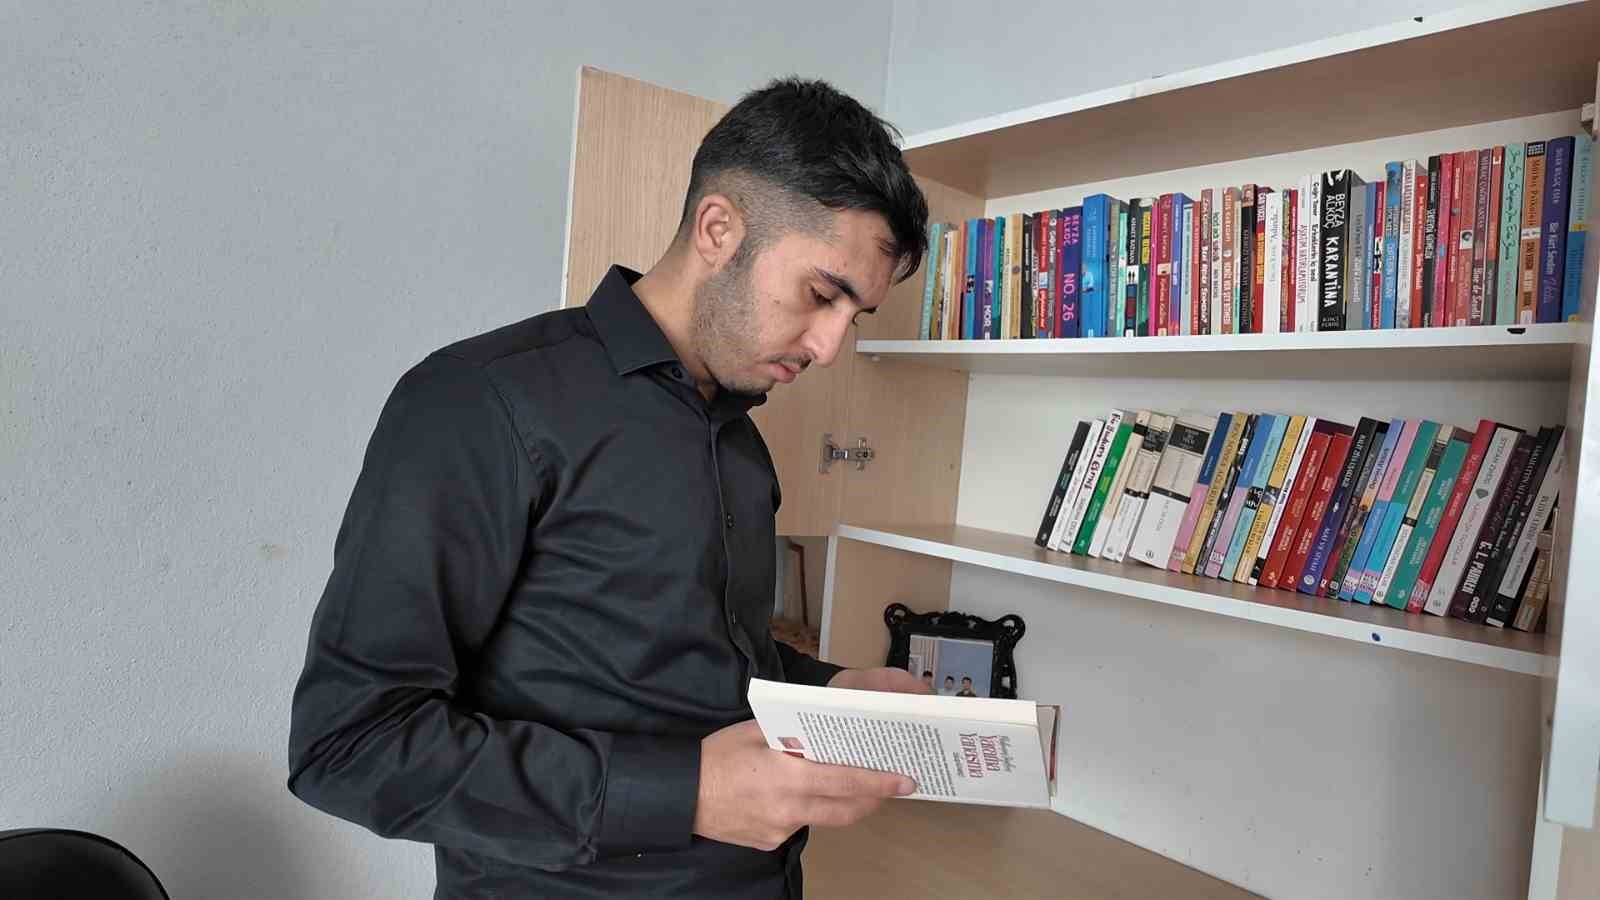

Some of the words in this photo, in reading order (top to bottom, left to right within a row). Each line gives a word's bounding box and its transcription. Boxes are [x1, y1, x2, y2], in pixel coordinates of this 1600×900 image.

[1323, 195, 1336, 229] ALKOÇ
[1334, 193, 1346, 228] BEYZA
[1071, 214, 1080, 245] BEYZA
[1129, 240, 1137, 264] BATMAN
[1063, 273, 1075, 298] NO.
[1323, 236, 1341, 308] KARANTİNA
[1062, 303, 1075, 321] 26
